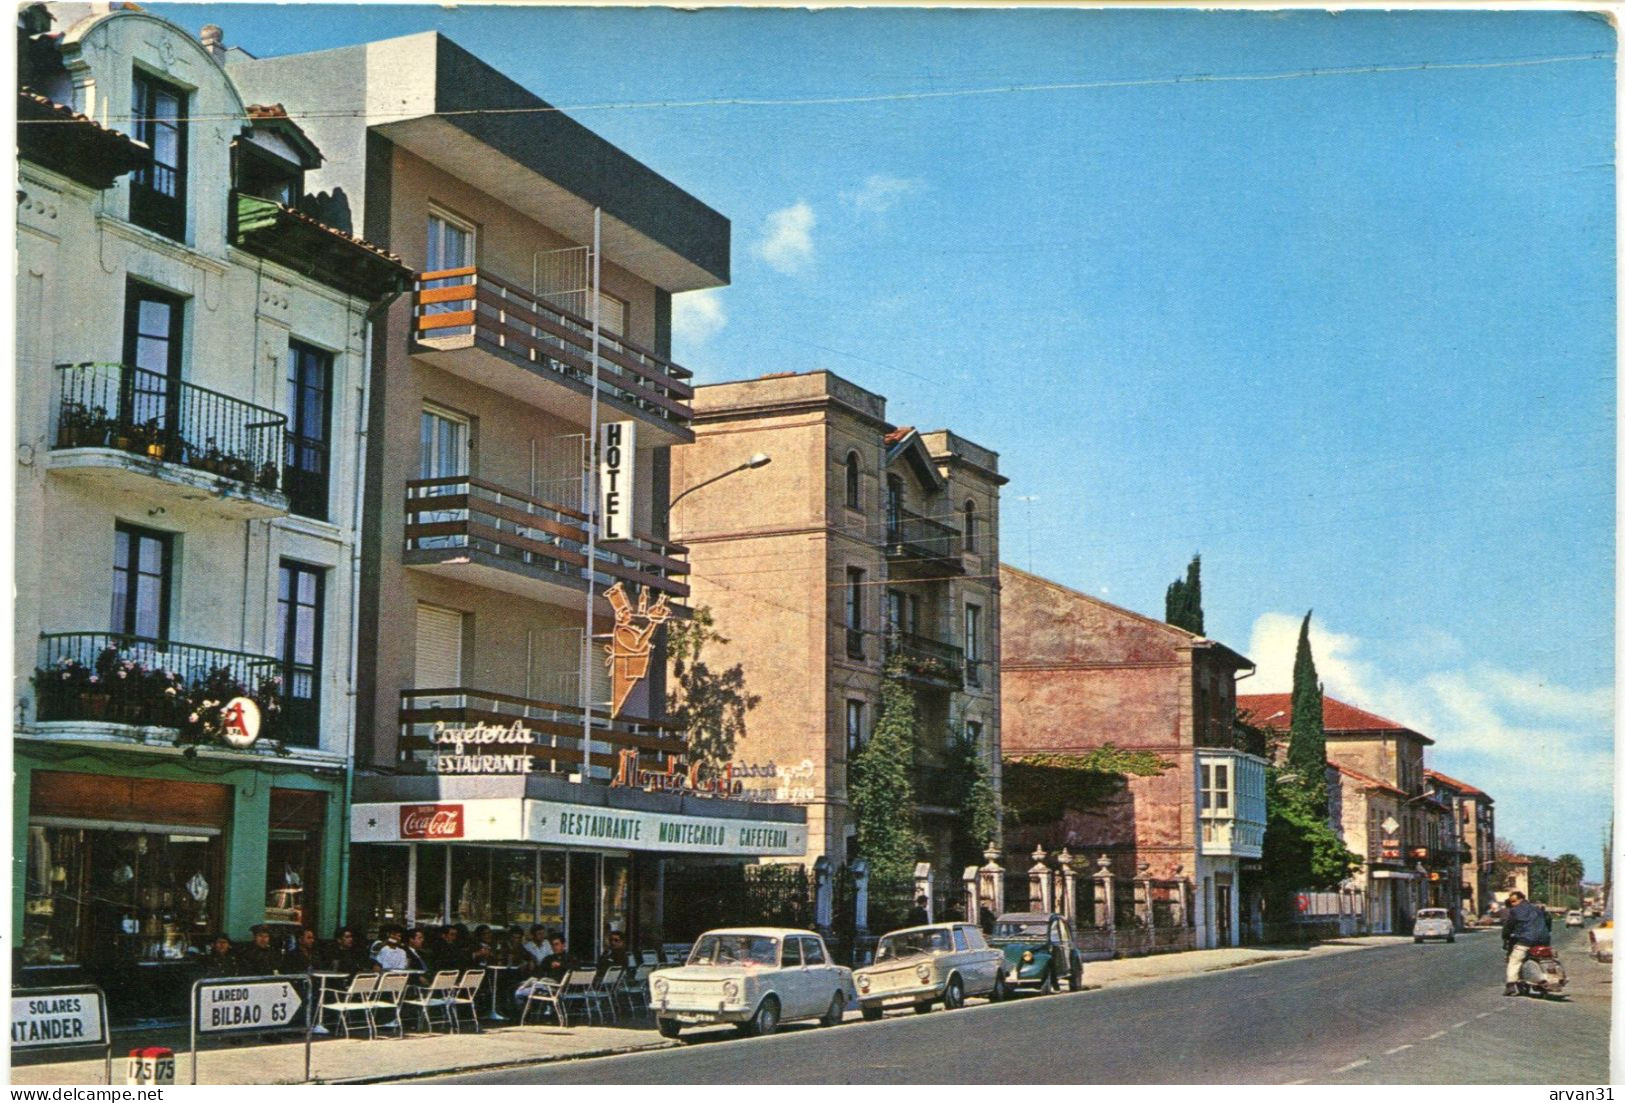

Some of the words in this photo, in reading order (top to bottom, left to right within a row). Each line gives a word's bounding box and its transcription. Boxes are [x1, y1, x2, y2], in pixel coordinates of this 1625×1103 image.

[606, 423, 622, 538] HOTEL
[428, 719, 535, 754] Cafeteria
[426, 754, 535, 773] RESTAURANTE
[559, 811, 642, 841] RESTAURANTE
[658, 821, 725, 847] MONTECARLO
[739, 827, 788, 849] CAFETERIA
[211, 987, 249, 1003] LAREDO
[281, 984, 288, 998] 3
[29, 998, 81, 1015] SOLARES
[211, 1004, 261, 1027] BILBAO
[271, 1002, 288, 1022] 63
[129, 1060, 152, 1080] 175
